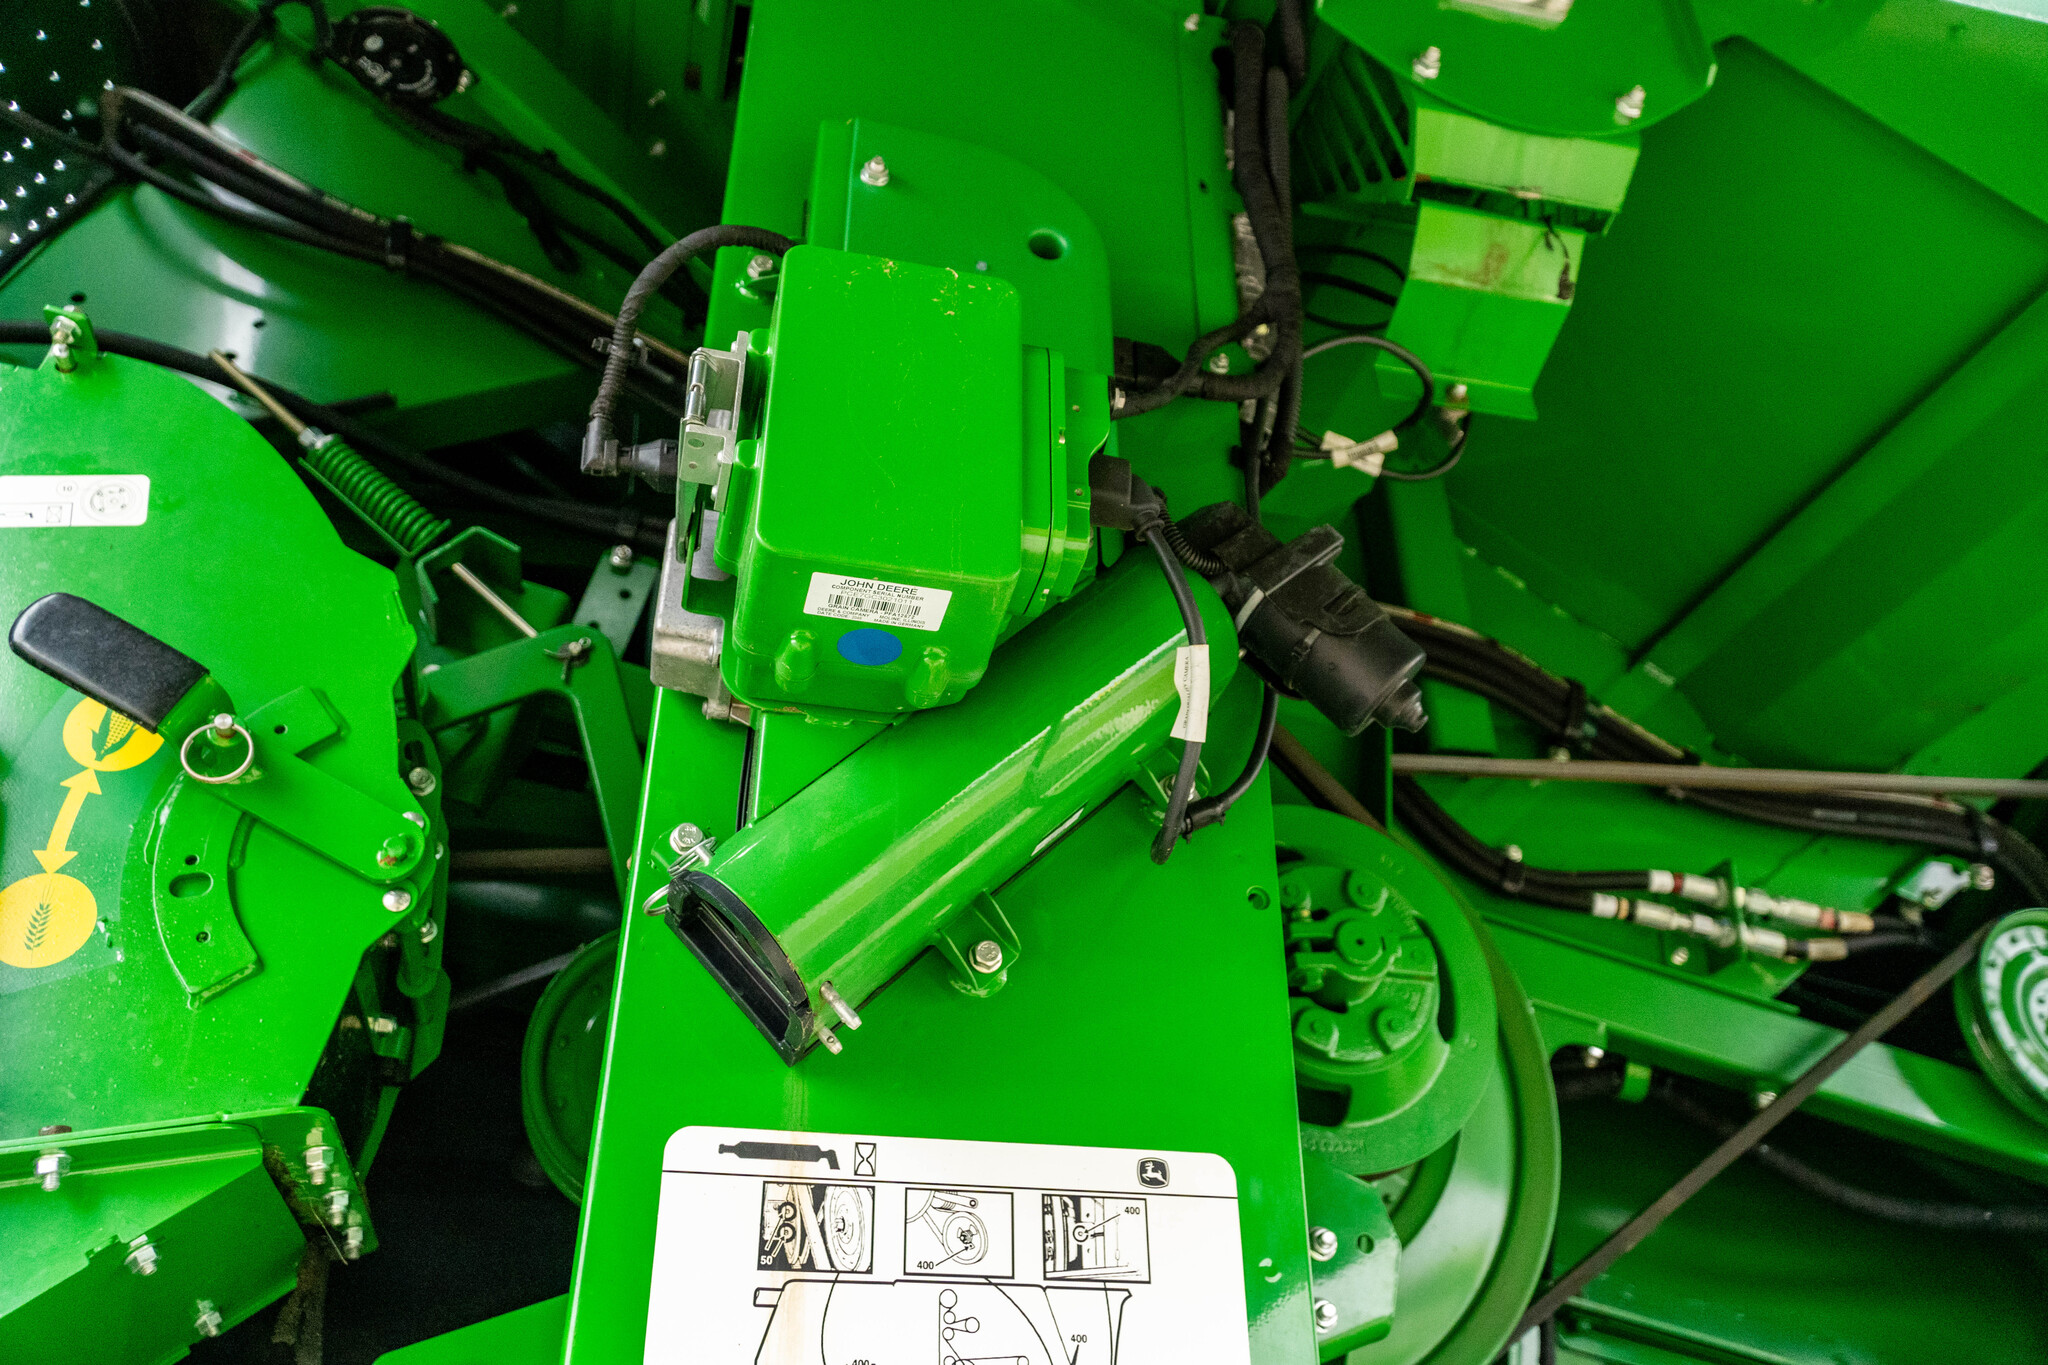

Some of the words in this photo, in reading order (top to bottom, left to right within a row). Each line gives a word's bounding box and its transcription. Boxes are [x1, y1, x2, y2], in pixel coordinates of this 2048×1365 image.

[831, 584, 871, 594] COMPONENT
[896, 593, 925, 601] NUMBER
[840, 579, 874, 590] JOHN
[877, 583, 919, 596] DEERE
[842, 610, 870, 618] COMPANY
[850, 606, 879, 614] CAMERA
[1124, 1206, 1141, 1215] 400
[759, 1255, 773, 1265] 50
[916, 1260, 934, 1270] 400
[1070, 1334, 1088, 1344] 400
